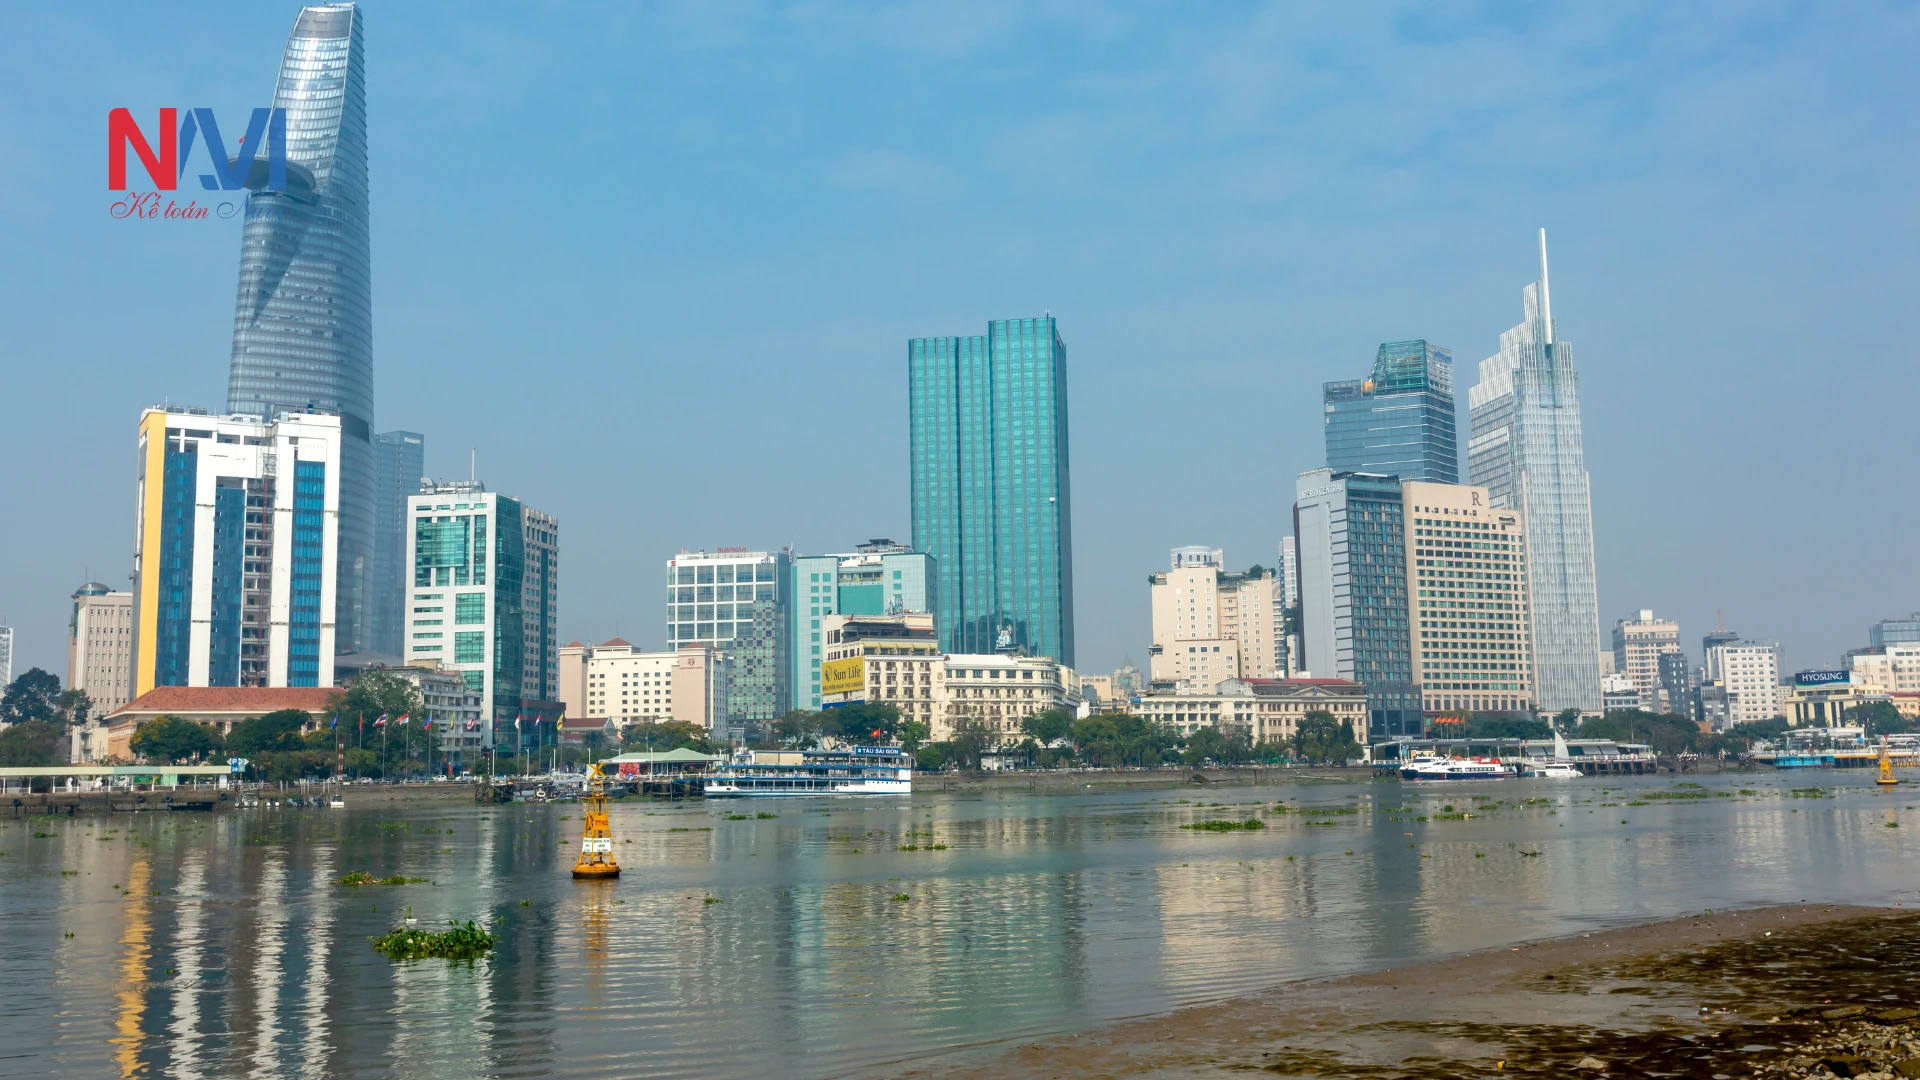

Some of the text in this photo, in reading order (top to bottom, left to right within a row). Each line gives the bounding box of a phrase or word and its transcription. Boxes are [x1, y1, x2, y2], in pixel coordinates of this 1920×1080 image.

[1471, 491, 1482, 506] R
[833, 665, 861, 680] Sun Life
[1802, 672, 1842, 681] HYOSUNG
